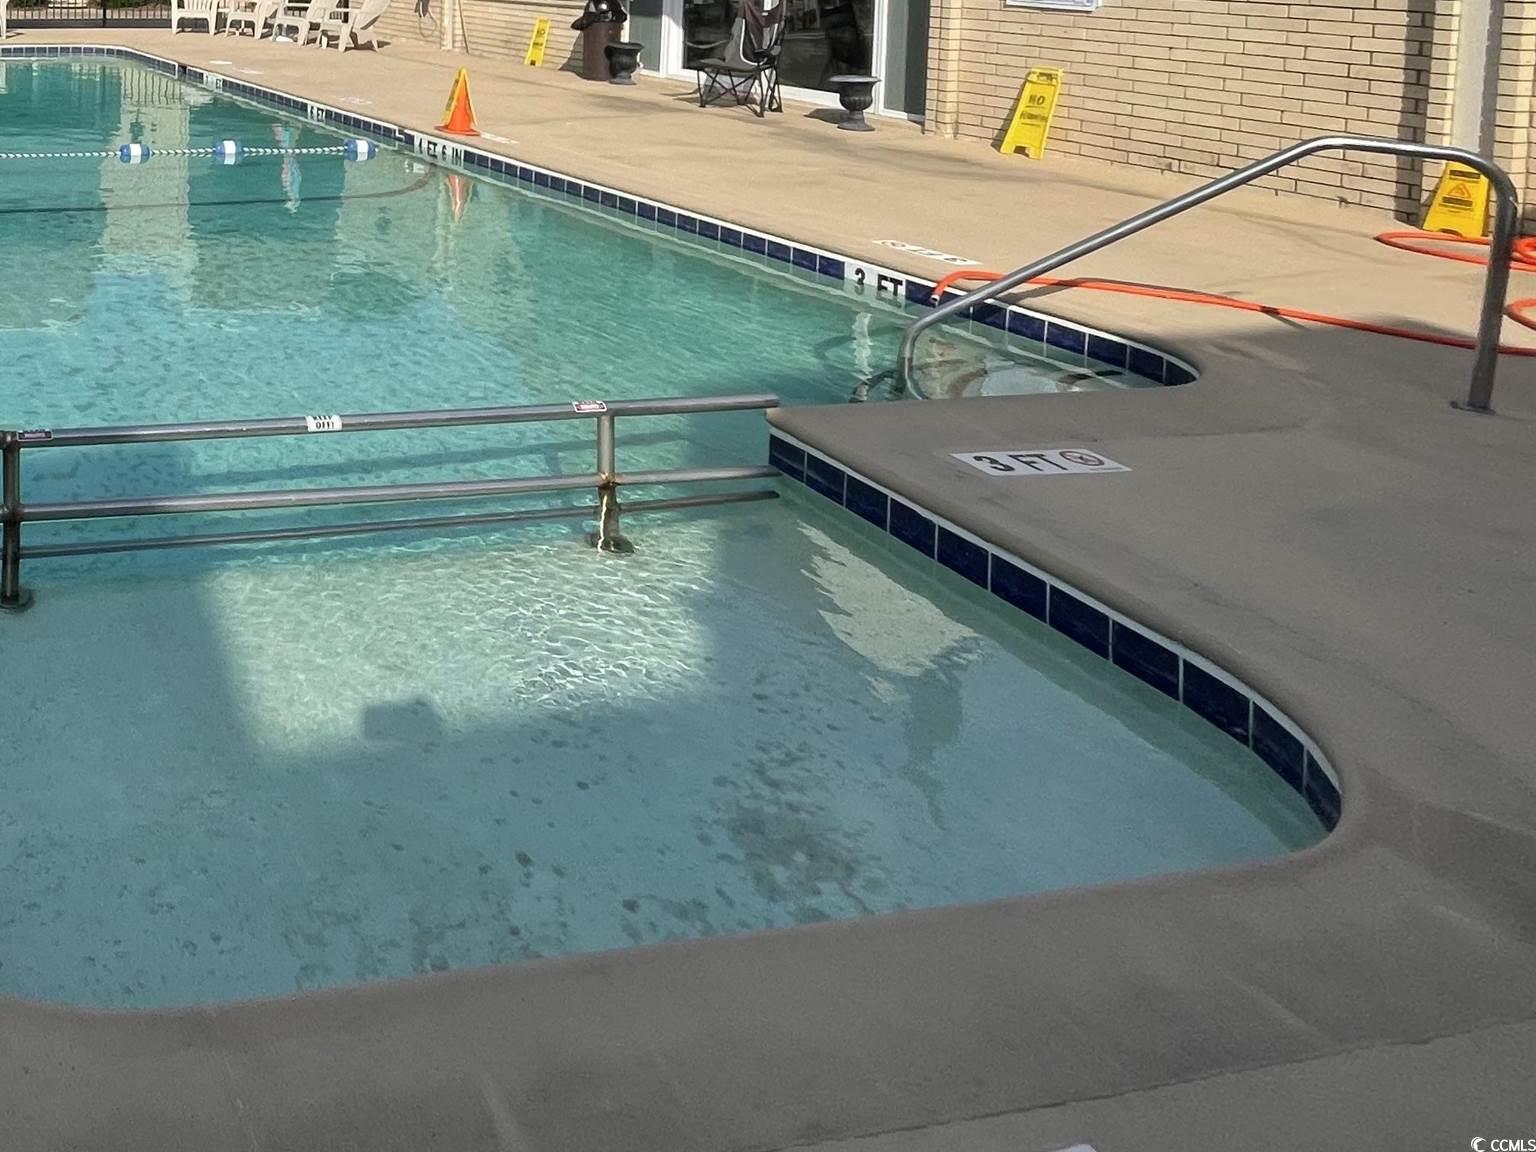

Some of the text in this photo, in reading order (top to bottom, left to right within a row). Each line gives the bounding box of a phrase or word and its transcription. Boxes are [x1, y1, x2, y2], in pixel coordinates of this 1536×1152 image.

[1028, 94, 1046, 105] NO
[877, 274, 903, 299] FT
[973, 453, 1068, 472] 3 FT
